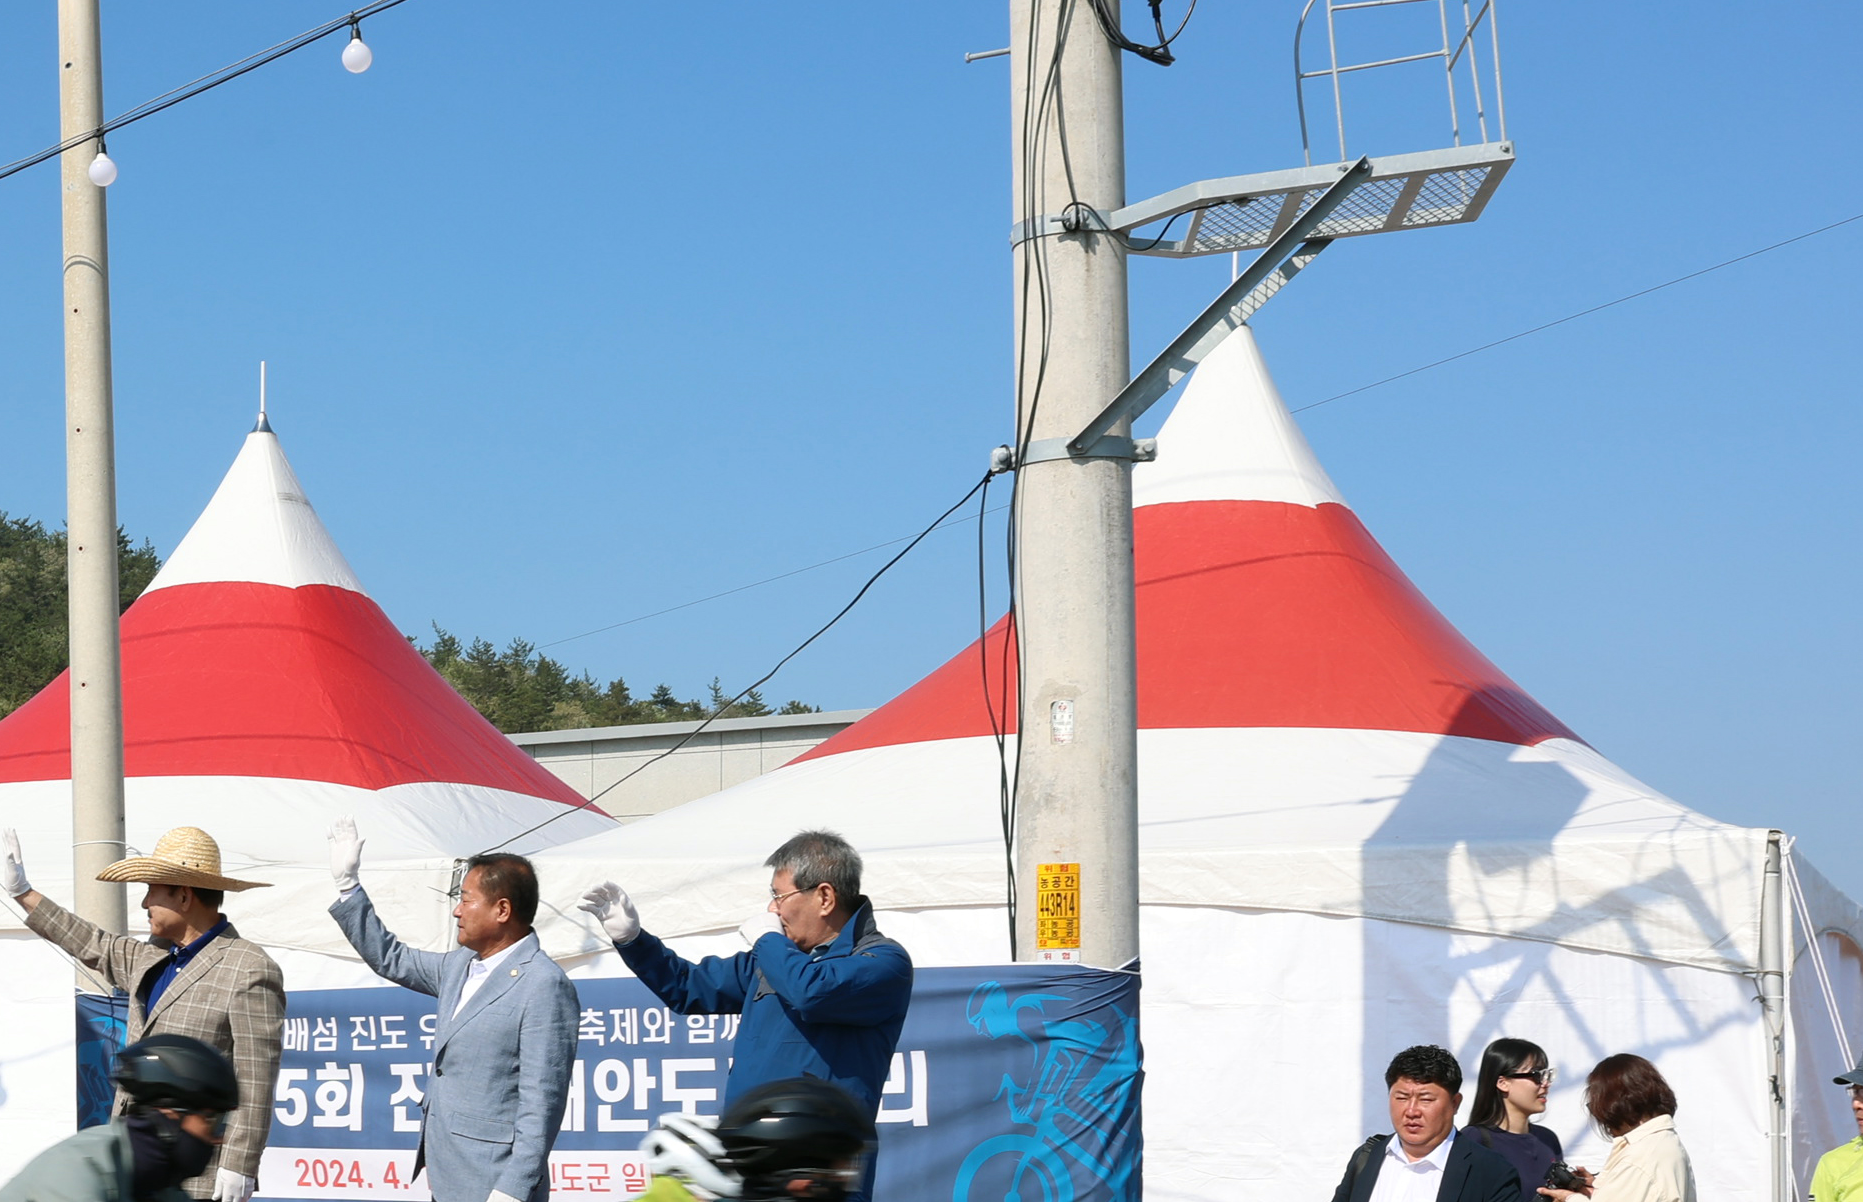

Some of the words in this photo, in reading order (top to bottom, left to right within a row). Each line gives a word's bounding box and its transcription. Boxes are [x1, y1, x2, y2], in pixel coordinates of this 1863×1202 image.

[282, 1016, 338, 1052] 배섬
[348, 1014, 409, 1051] 진도
[274, 1061, 365, 1132] 5회
